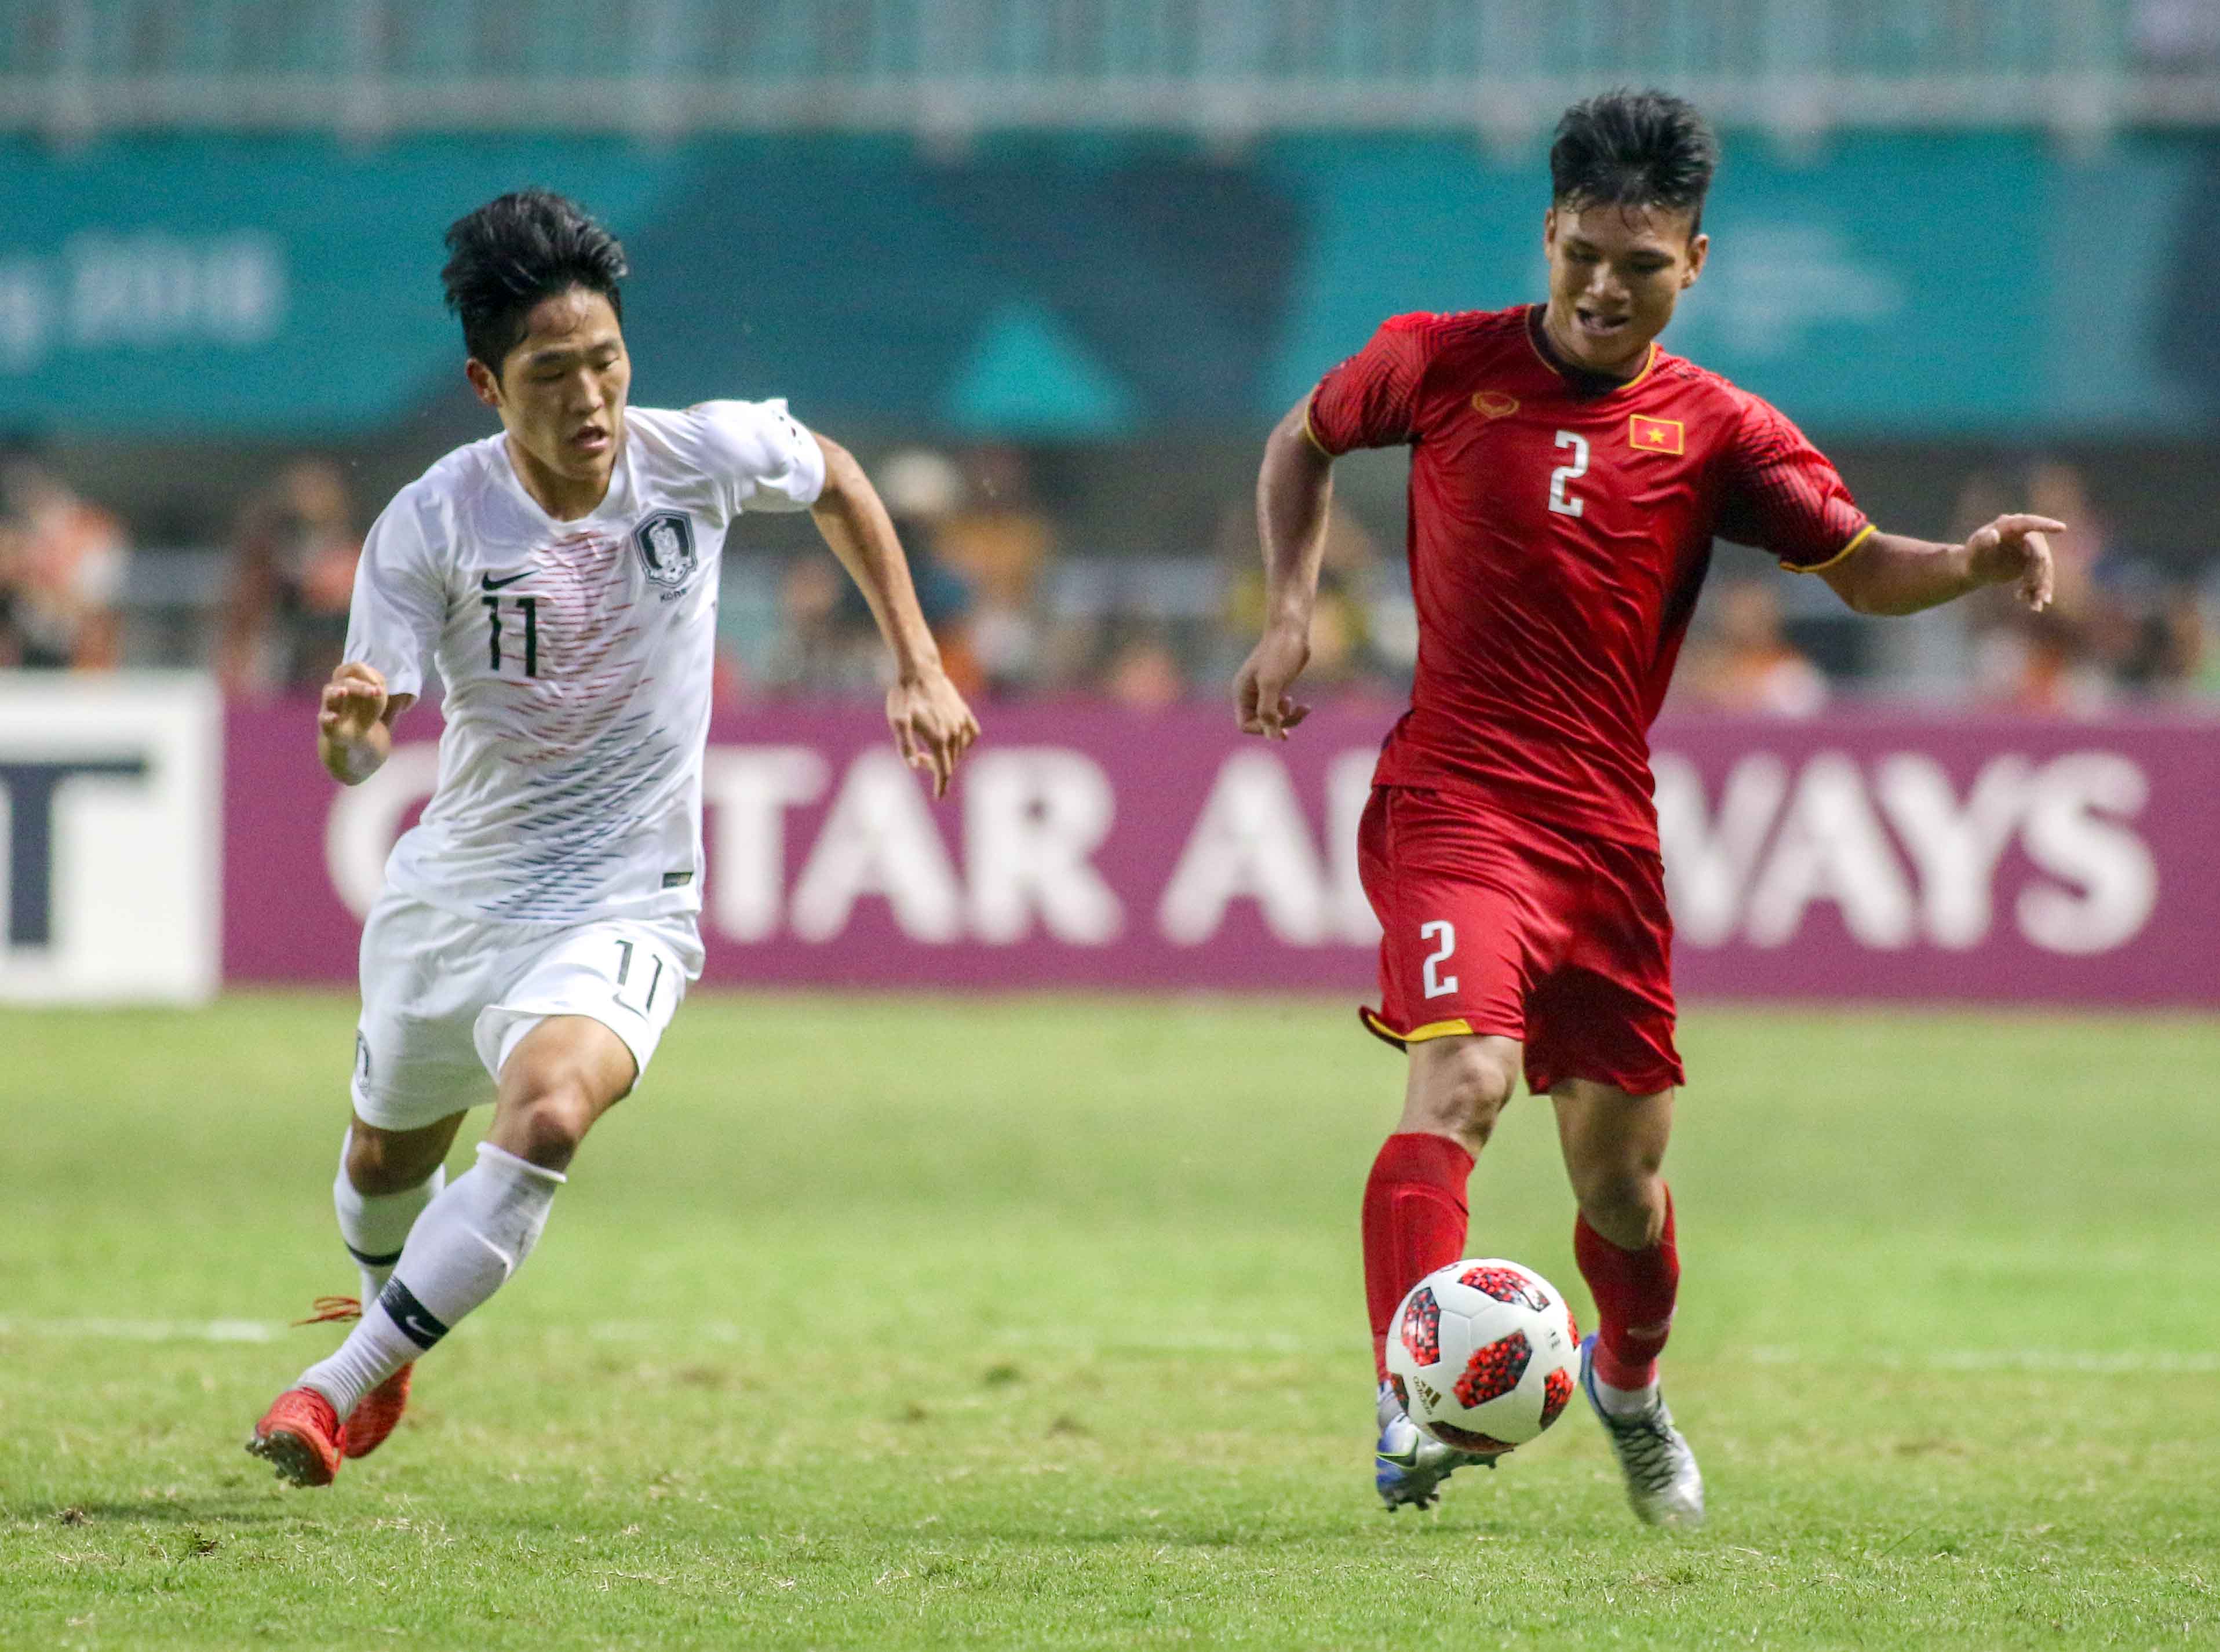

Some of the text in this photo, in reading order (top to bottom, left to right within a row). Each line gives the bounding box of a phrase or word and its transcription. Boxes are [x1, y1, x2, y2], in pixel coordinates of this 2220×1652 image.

[1548, 429, 1590, 517] 2
[482, 596, 536, 677] 11
[614, 939, 663, 1014] 11
[1421, 920, 1459, 999] 2
